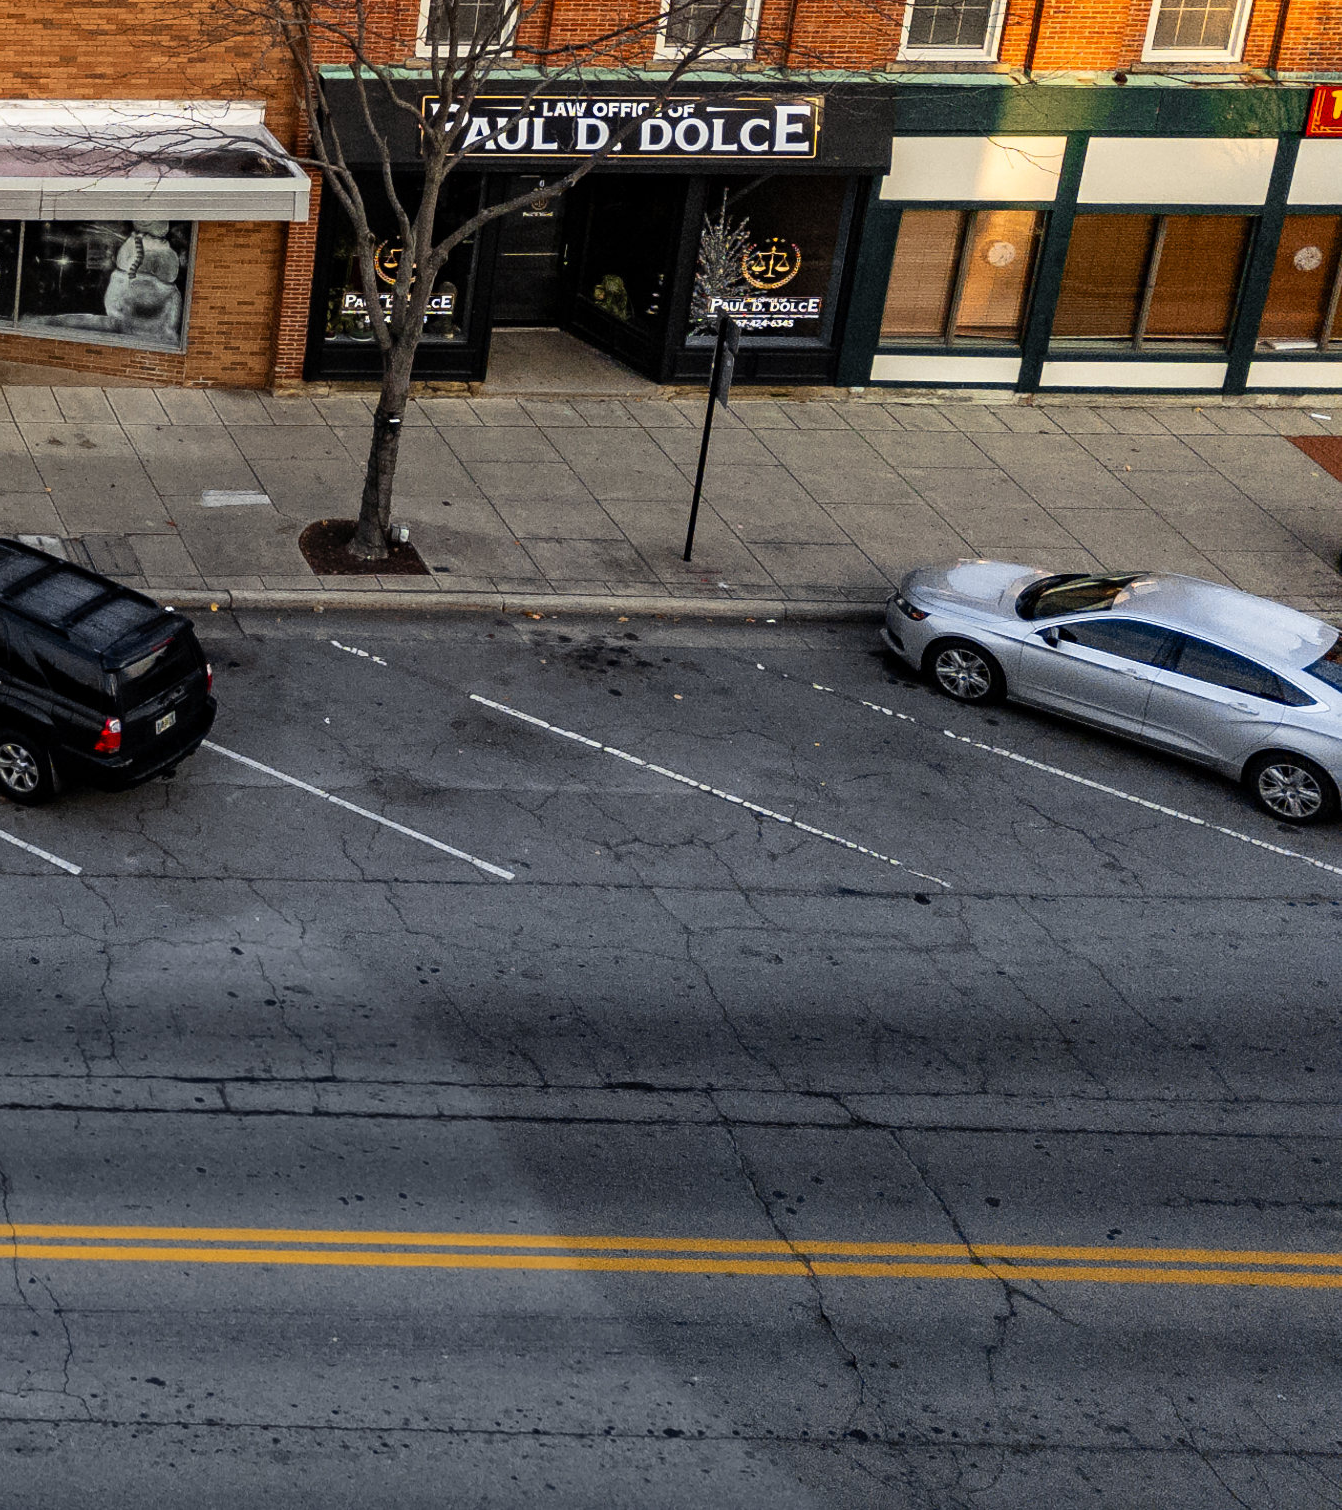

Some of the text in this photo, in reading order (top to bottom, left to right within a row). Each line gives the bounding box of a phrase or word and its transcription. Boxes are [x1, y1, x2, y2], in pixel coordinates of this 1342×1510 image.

[542, 102, 586, 118] LAW
[667, 103, 696, 118] OF
[639, 104, 812, 152] DOLCE
[709, 298, 748, 313] PAUL
[751, 301, 766, 312] D.
[769, 298, 820, 313] DOLCE
[733, 319, 795, 328] 67-424-6345
